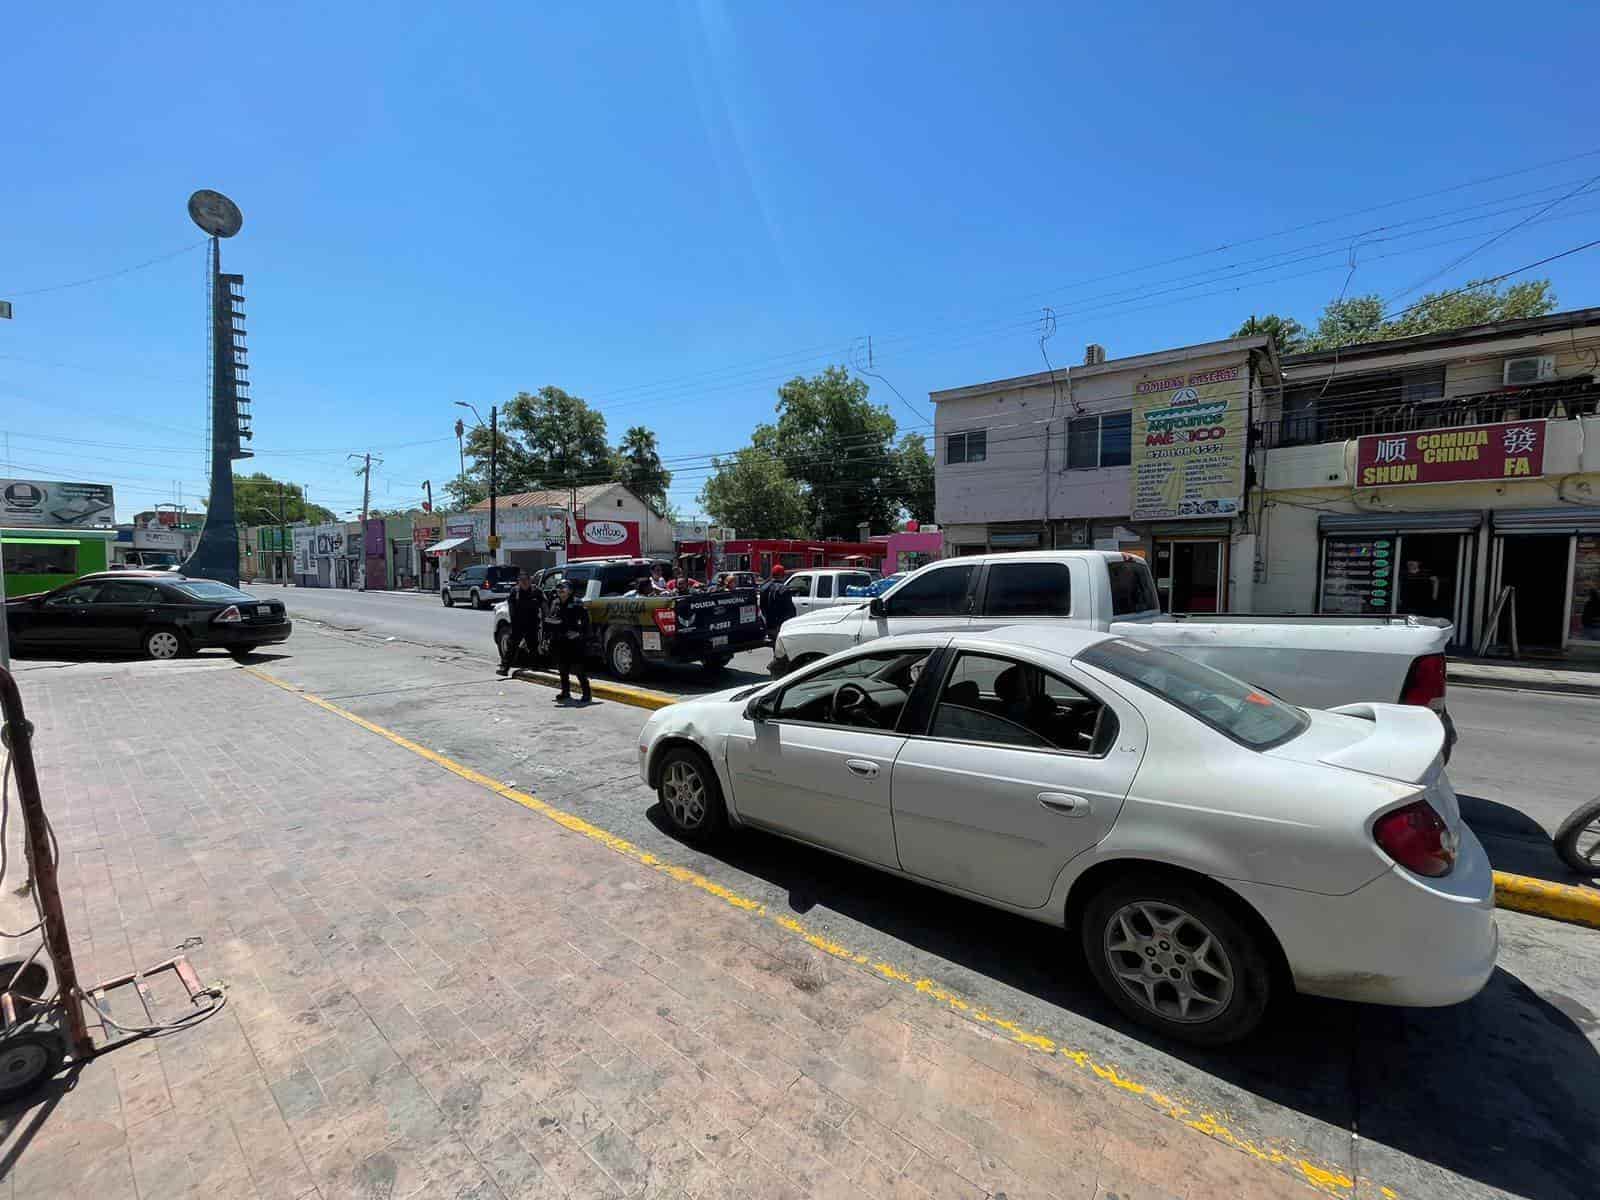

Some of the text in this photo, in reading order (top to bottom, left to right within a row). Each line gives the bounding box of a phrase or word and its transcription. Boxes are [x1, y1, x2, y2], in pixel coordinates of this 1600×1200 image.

[1416, 430, 1488, 450] COMIDA
[1503, 426, 1537, 454] 發
[1375, 438, 1408, 463] 顺
[1423, 446, 1480, 464] CHINA
[1363, 463, 1418, 484] SHUN
[1503, 456, 1530, 476] FA
[690, 600, 716, 609] POLICIA
